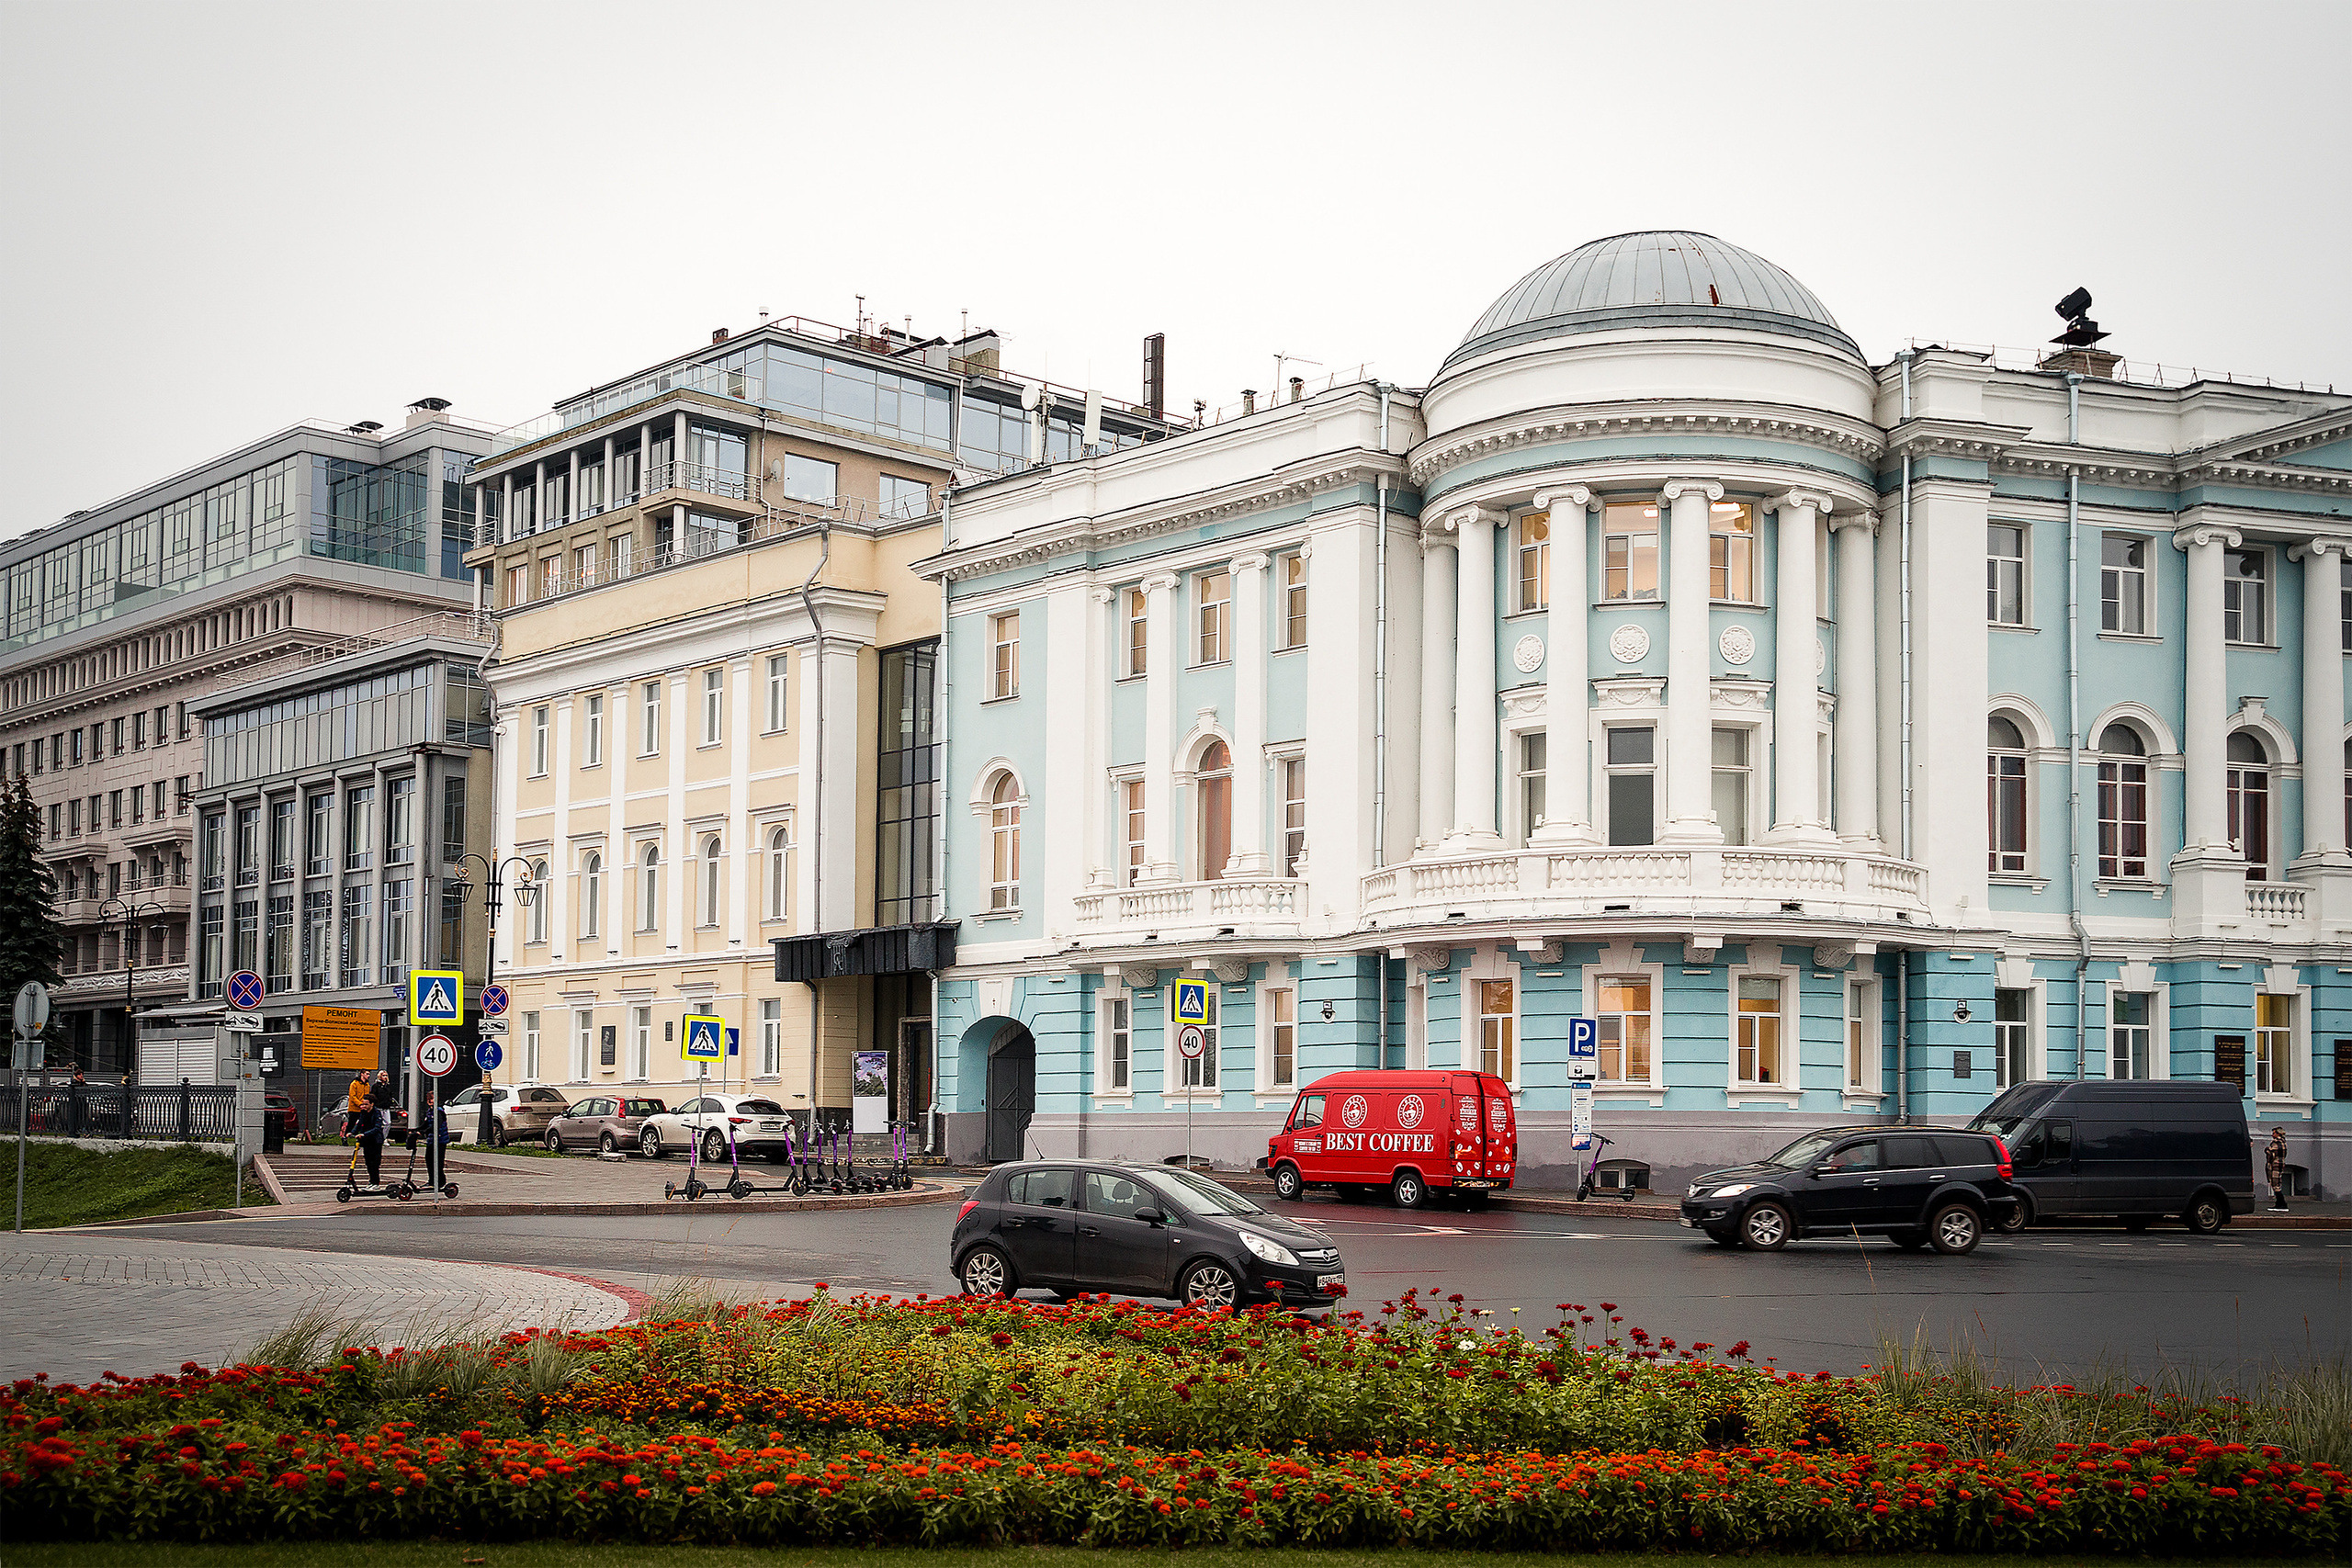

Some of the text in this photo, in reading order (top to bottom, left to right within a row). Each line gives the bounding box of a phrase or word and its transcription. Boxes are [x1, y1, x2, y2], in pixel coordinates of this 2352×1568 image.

[327, 1010, 358, 1018] РЕМОНТ
[1183, 1035, 1198, 1048] 40
[424, 1047, 448, 1064] 40
[1325, 1133, 1434, 1152] BEST COFFEE
